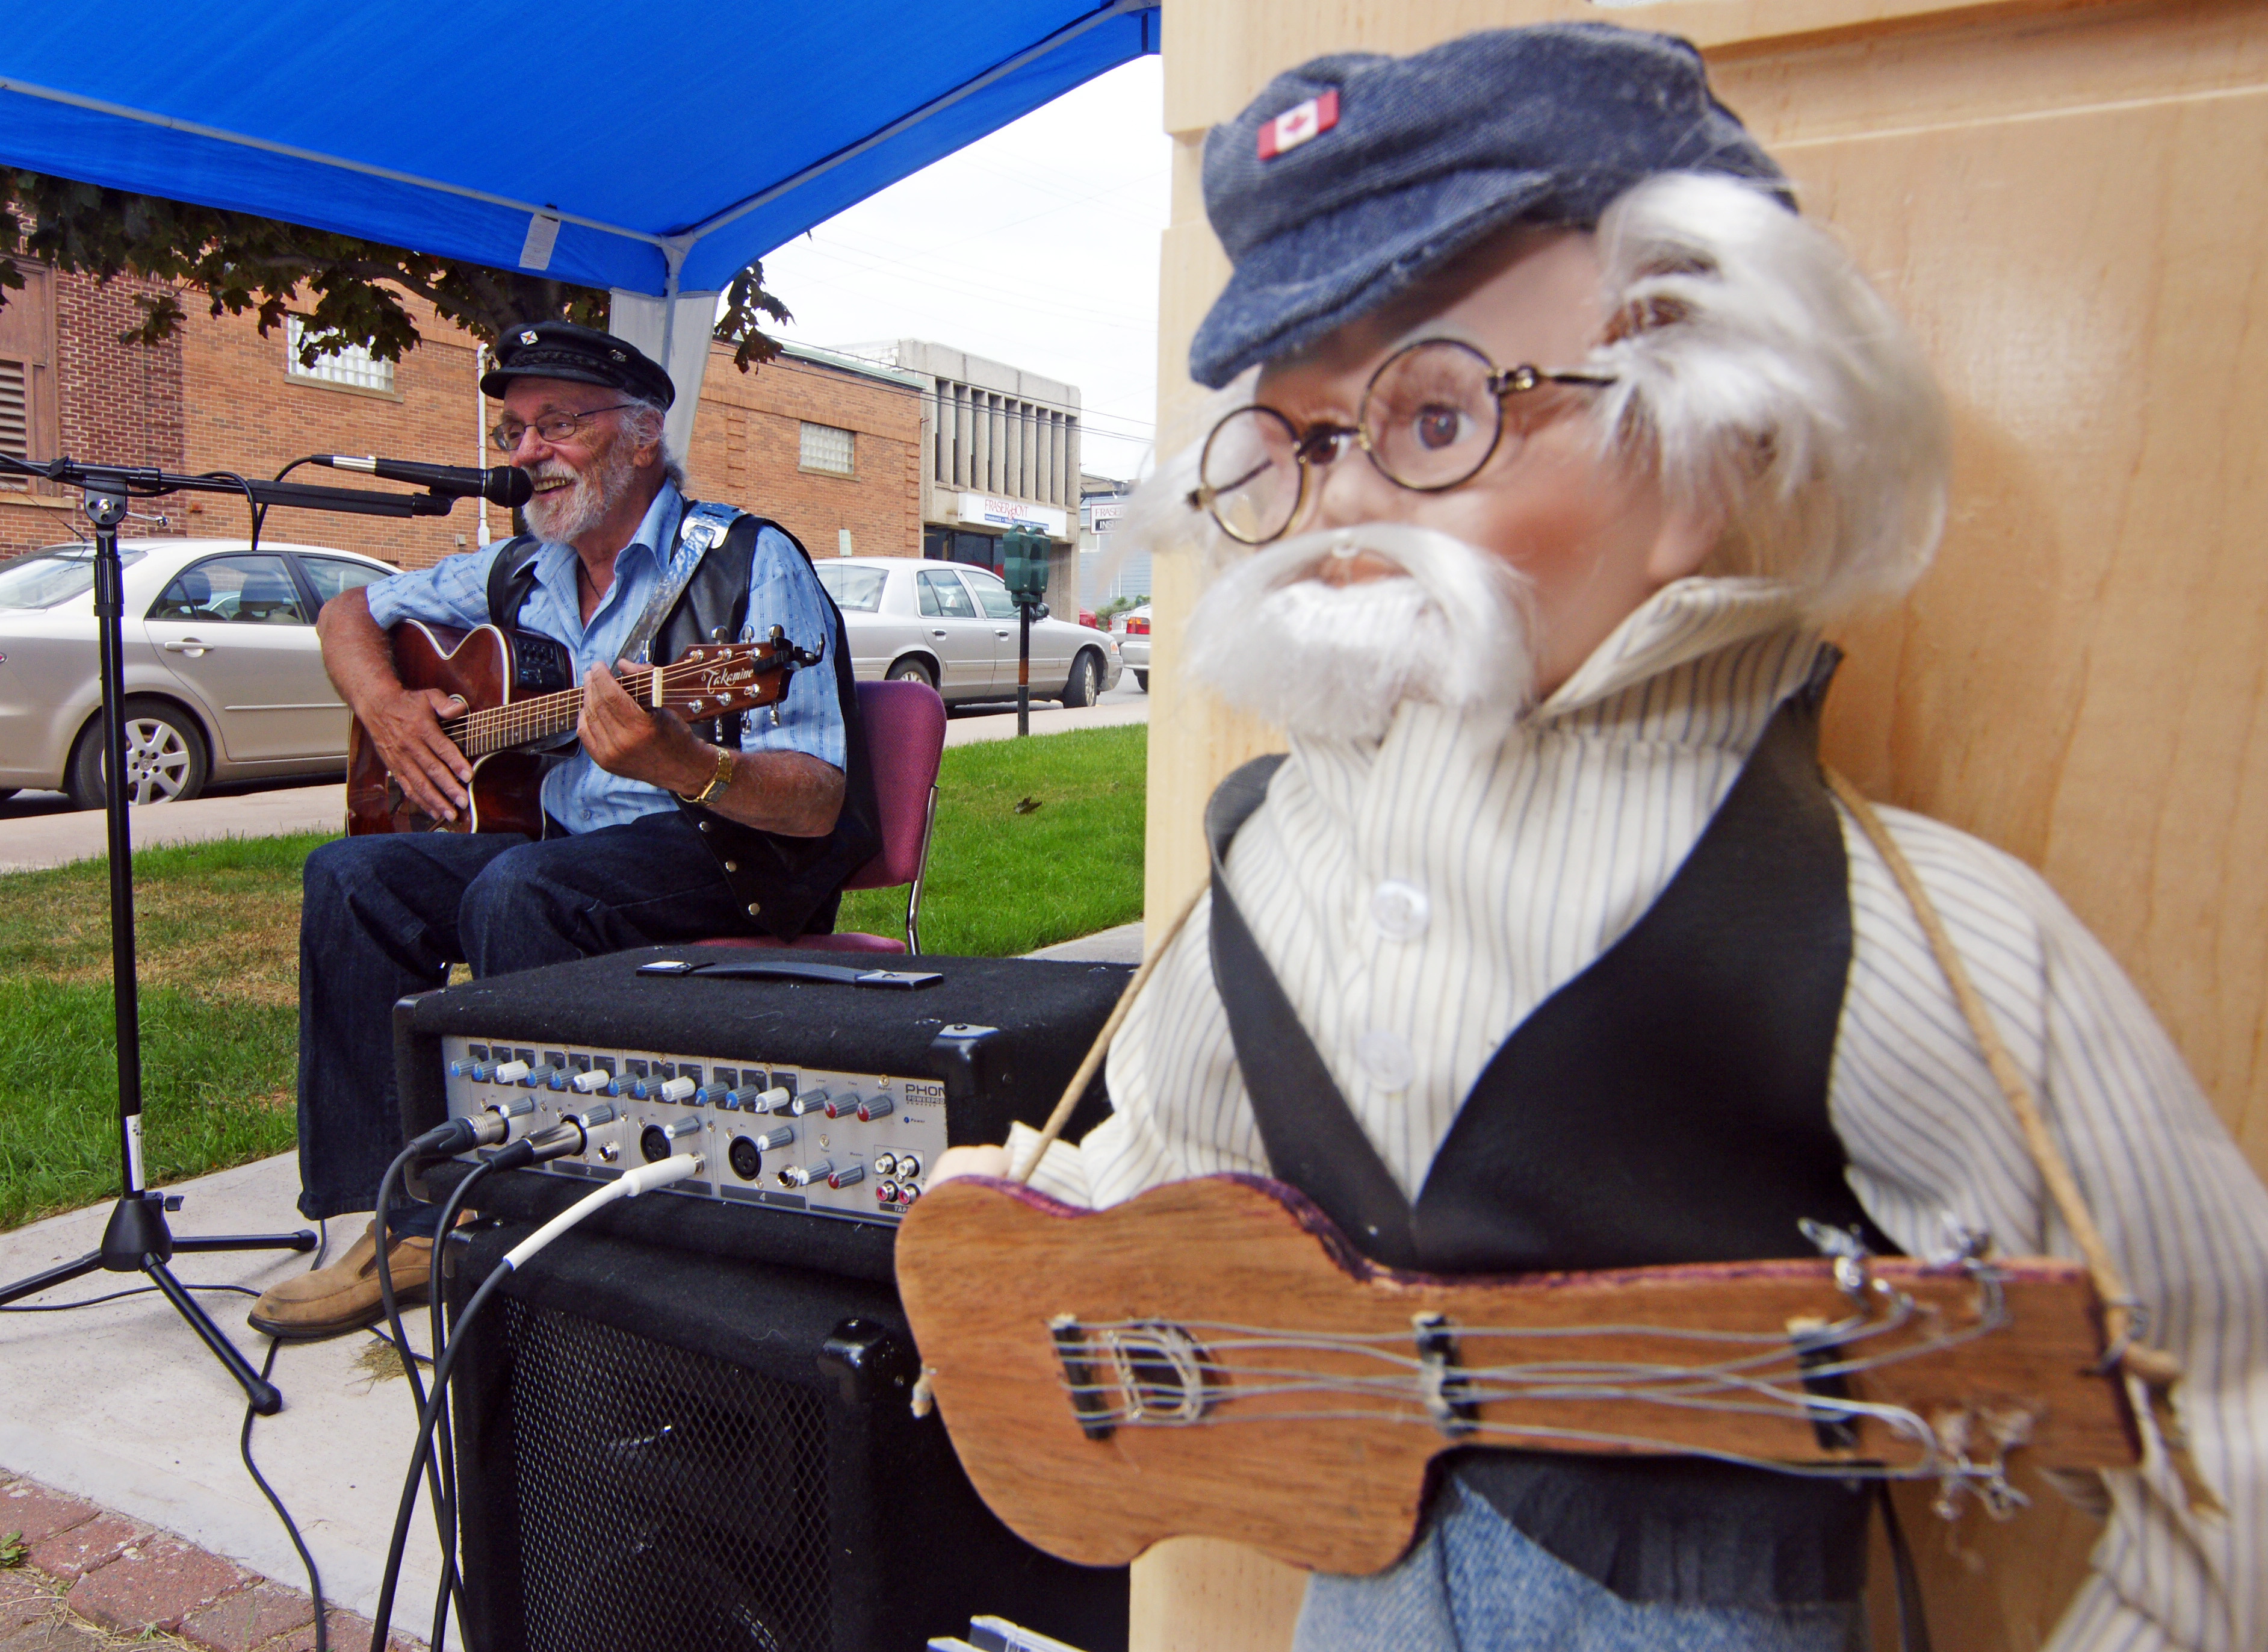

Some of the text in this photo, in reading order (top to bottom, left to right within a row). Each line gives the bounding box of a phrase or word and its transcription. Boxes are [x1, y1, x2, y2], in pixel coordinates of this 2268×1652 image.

[985, 499, 1009, 514] FRASER
[1012, 505, 1029, 517] HOYT
[701, 668, 754, 694] Takamine
[586, 1167, 592, 1175] 2
[759, 1192, 766, 1203] 4
[894, 1205, 908, 1214] TAP
